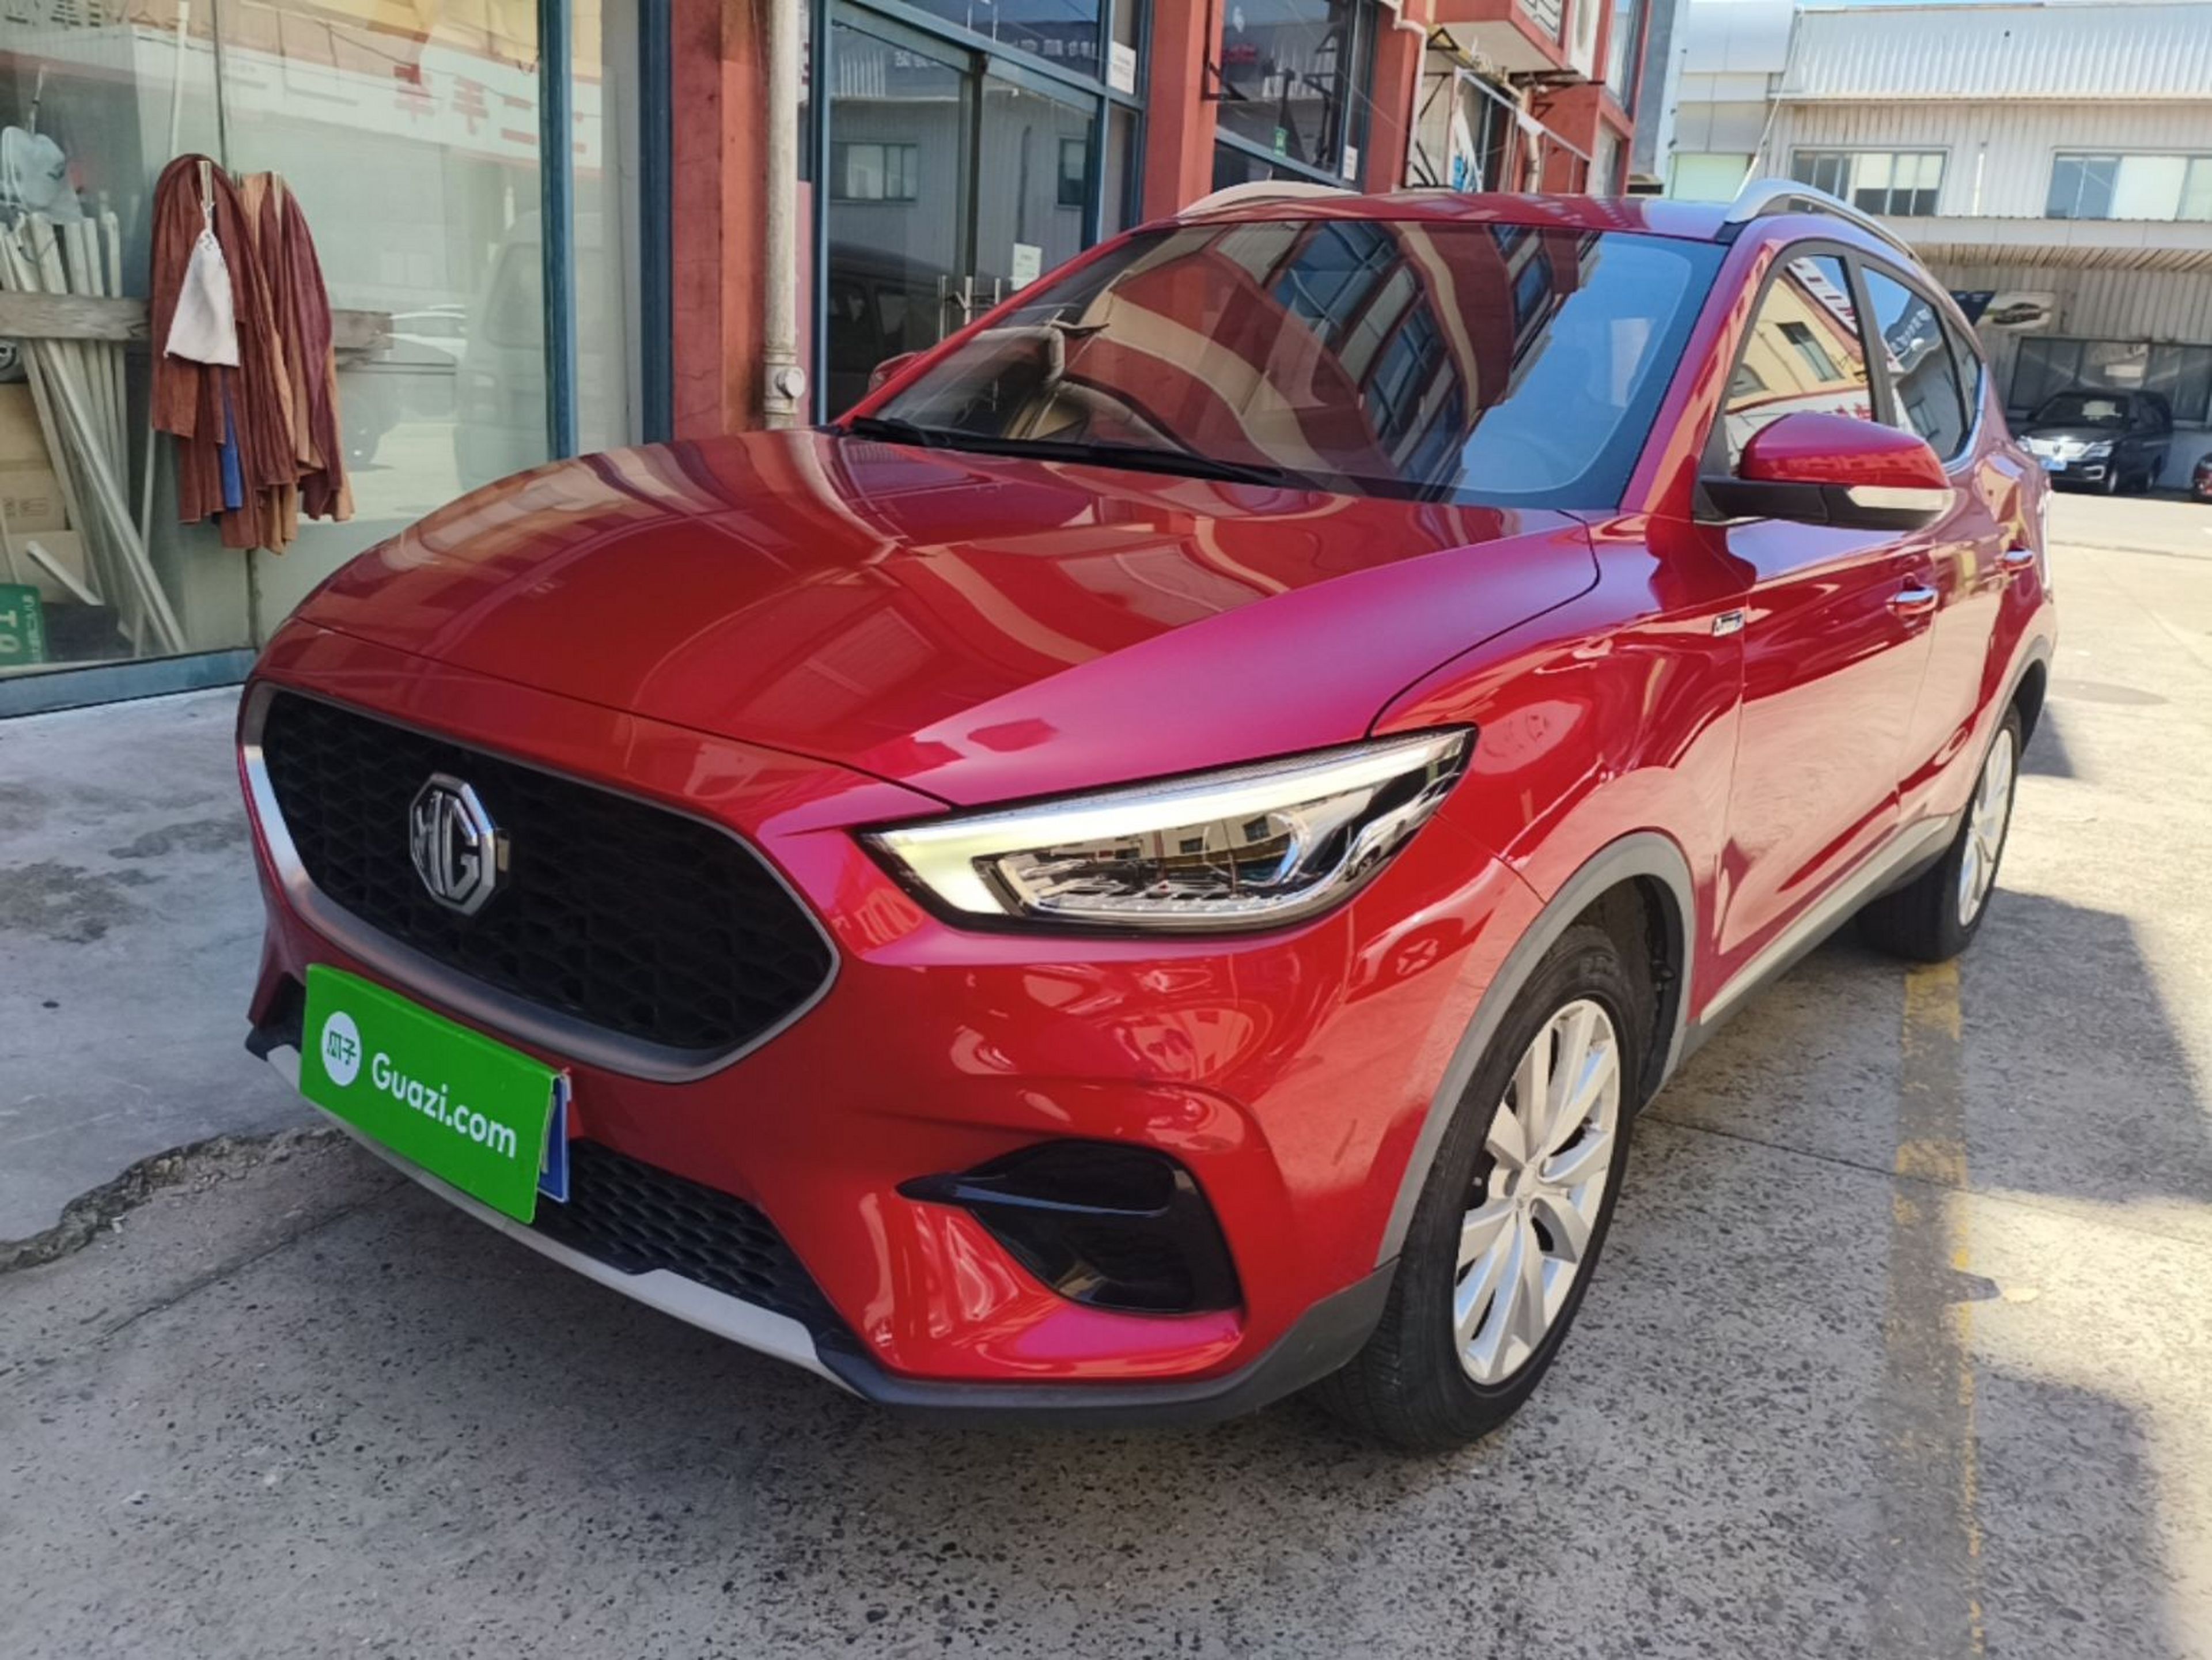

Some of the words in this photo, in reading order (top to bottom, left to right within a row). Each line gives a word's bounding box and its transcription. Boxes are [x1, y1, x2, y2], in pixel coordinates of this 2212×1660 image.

[412, 786, 483, 906] MG
[327, 1030, 357, 1065] 瓜子
[372, 1052, 516, 1159] Guazi.com
